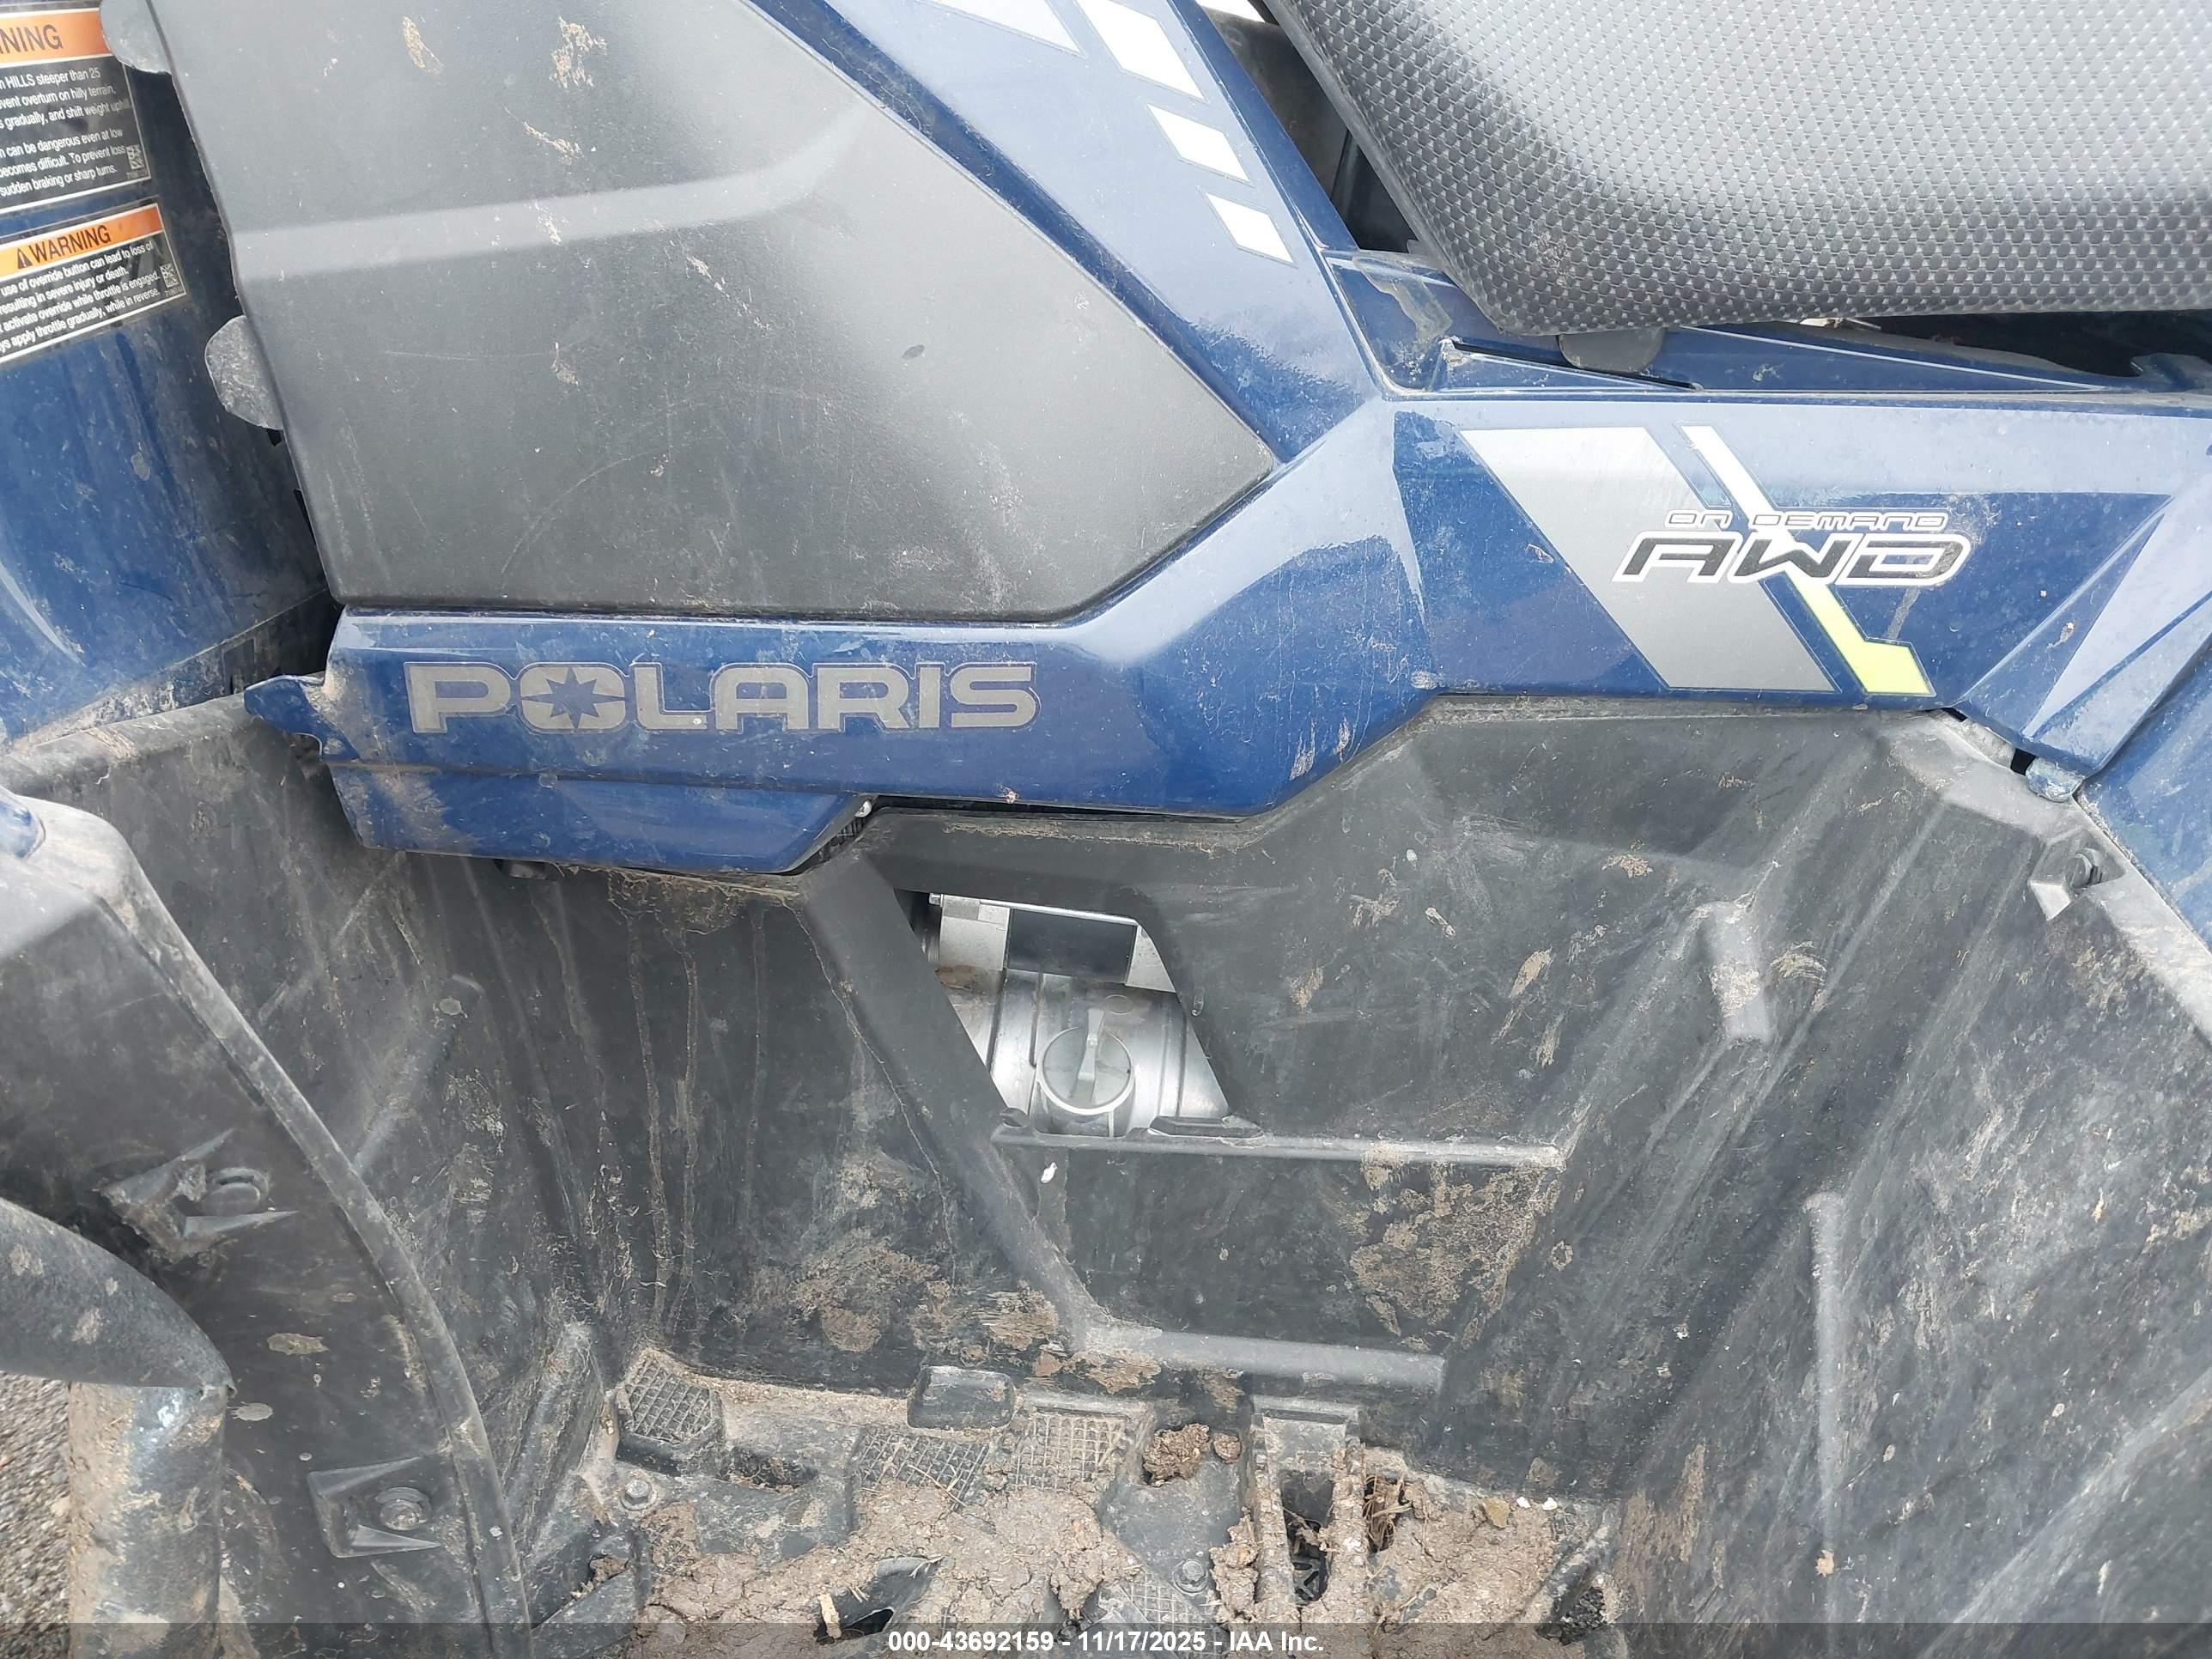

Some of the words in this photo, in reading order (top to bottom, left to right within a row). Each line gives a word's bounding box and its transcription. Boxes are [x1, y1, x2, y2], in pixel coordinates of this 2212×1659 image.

[0, 24, 64, 56] NING
[6, 74, 36, 88] HILLS
[36, 73, 69, 89] steeper
[70, 69, 88, 81] than
[89, 67, 101, 78] 25
[21, 93, 58, 106] overturn
[59, 92, 70, 100] on
[71, 88, 88, 100] hilly
[88, 84, 116, 96] terrain,
[5, 112, 49, 131] gradually,
[50, 108, 65, 122] and
[66, 106, 84, 118] shift
[85, 101, 111, 117] weight
[6, 143, 24, 157] can
[25, 140, 37, 153] be
[37, 136, 81, 152] dangerous
[82, 131, 100, 144] even
[102, 130, 110, 140] at
[111, 127, 123, 138] low
[38, 155, 67, 171] difficult.
[70, 154, 81, 162] To
[82, 148, 111, 164] prevent
[111, 144, 125, 156] loss
[0, 184, 33, 198] sudden
[33, 173, 64, 191] braking
[64, 174, 74, 183] or
[75, 170, 96, 182] sharp
[96, 167, 117, 176] turns.
[28, 225, 111, 264] WARNING
[0, 284, 18, 297] use
[18, 280, 28, 291] of
[30, 271, 64, 289] override
[64, 264, 89, 278] button
[90, 258, 105, 270] can
[105, 252, 121, 266] lead
[122, 250, 131, 259] to
[131, 245, 147, 258] loss
[146, 240, 153, 251] of
[0, 295, 37, 315] resulting
[36, 291, 46, 303] in
[46, 285, 73, 300] severe
[73, 278, 95, 295] injury
[95, 276, 105, 284] or
[106, 268, 129, 282] death.
[3, 313, 39, 331] activate
[39, 302, 72, 319] override
[72, 294, 94, 308] while
[94, 284, 122, 301] throttle
[122, 280, 129, 290] is
[129, 272, 161, 289] engaged.
[10, 329, 36, 349] apply
[35, 319, 67, 337] throttle
[67, 307, 106, 330] gradually,
[106, 298, 125, 313] while
[125, 296, 134, 307] in
[1749, 510, 1948, 531] DEMAND
[1612, 531, 1972, 586] AWD
[404, 662, 1040, 733] POLARIS
